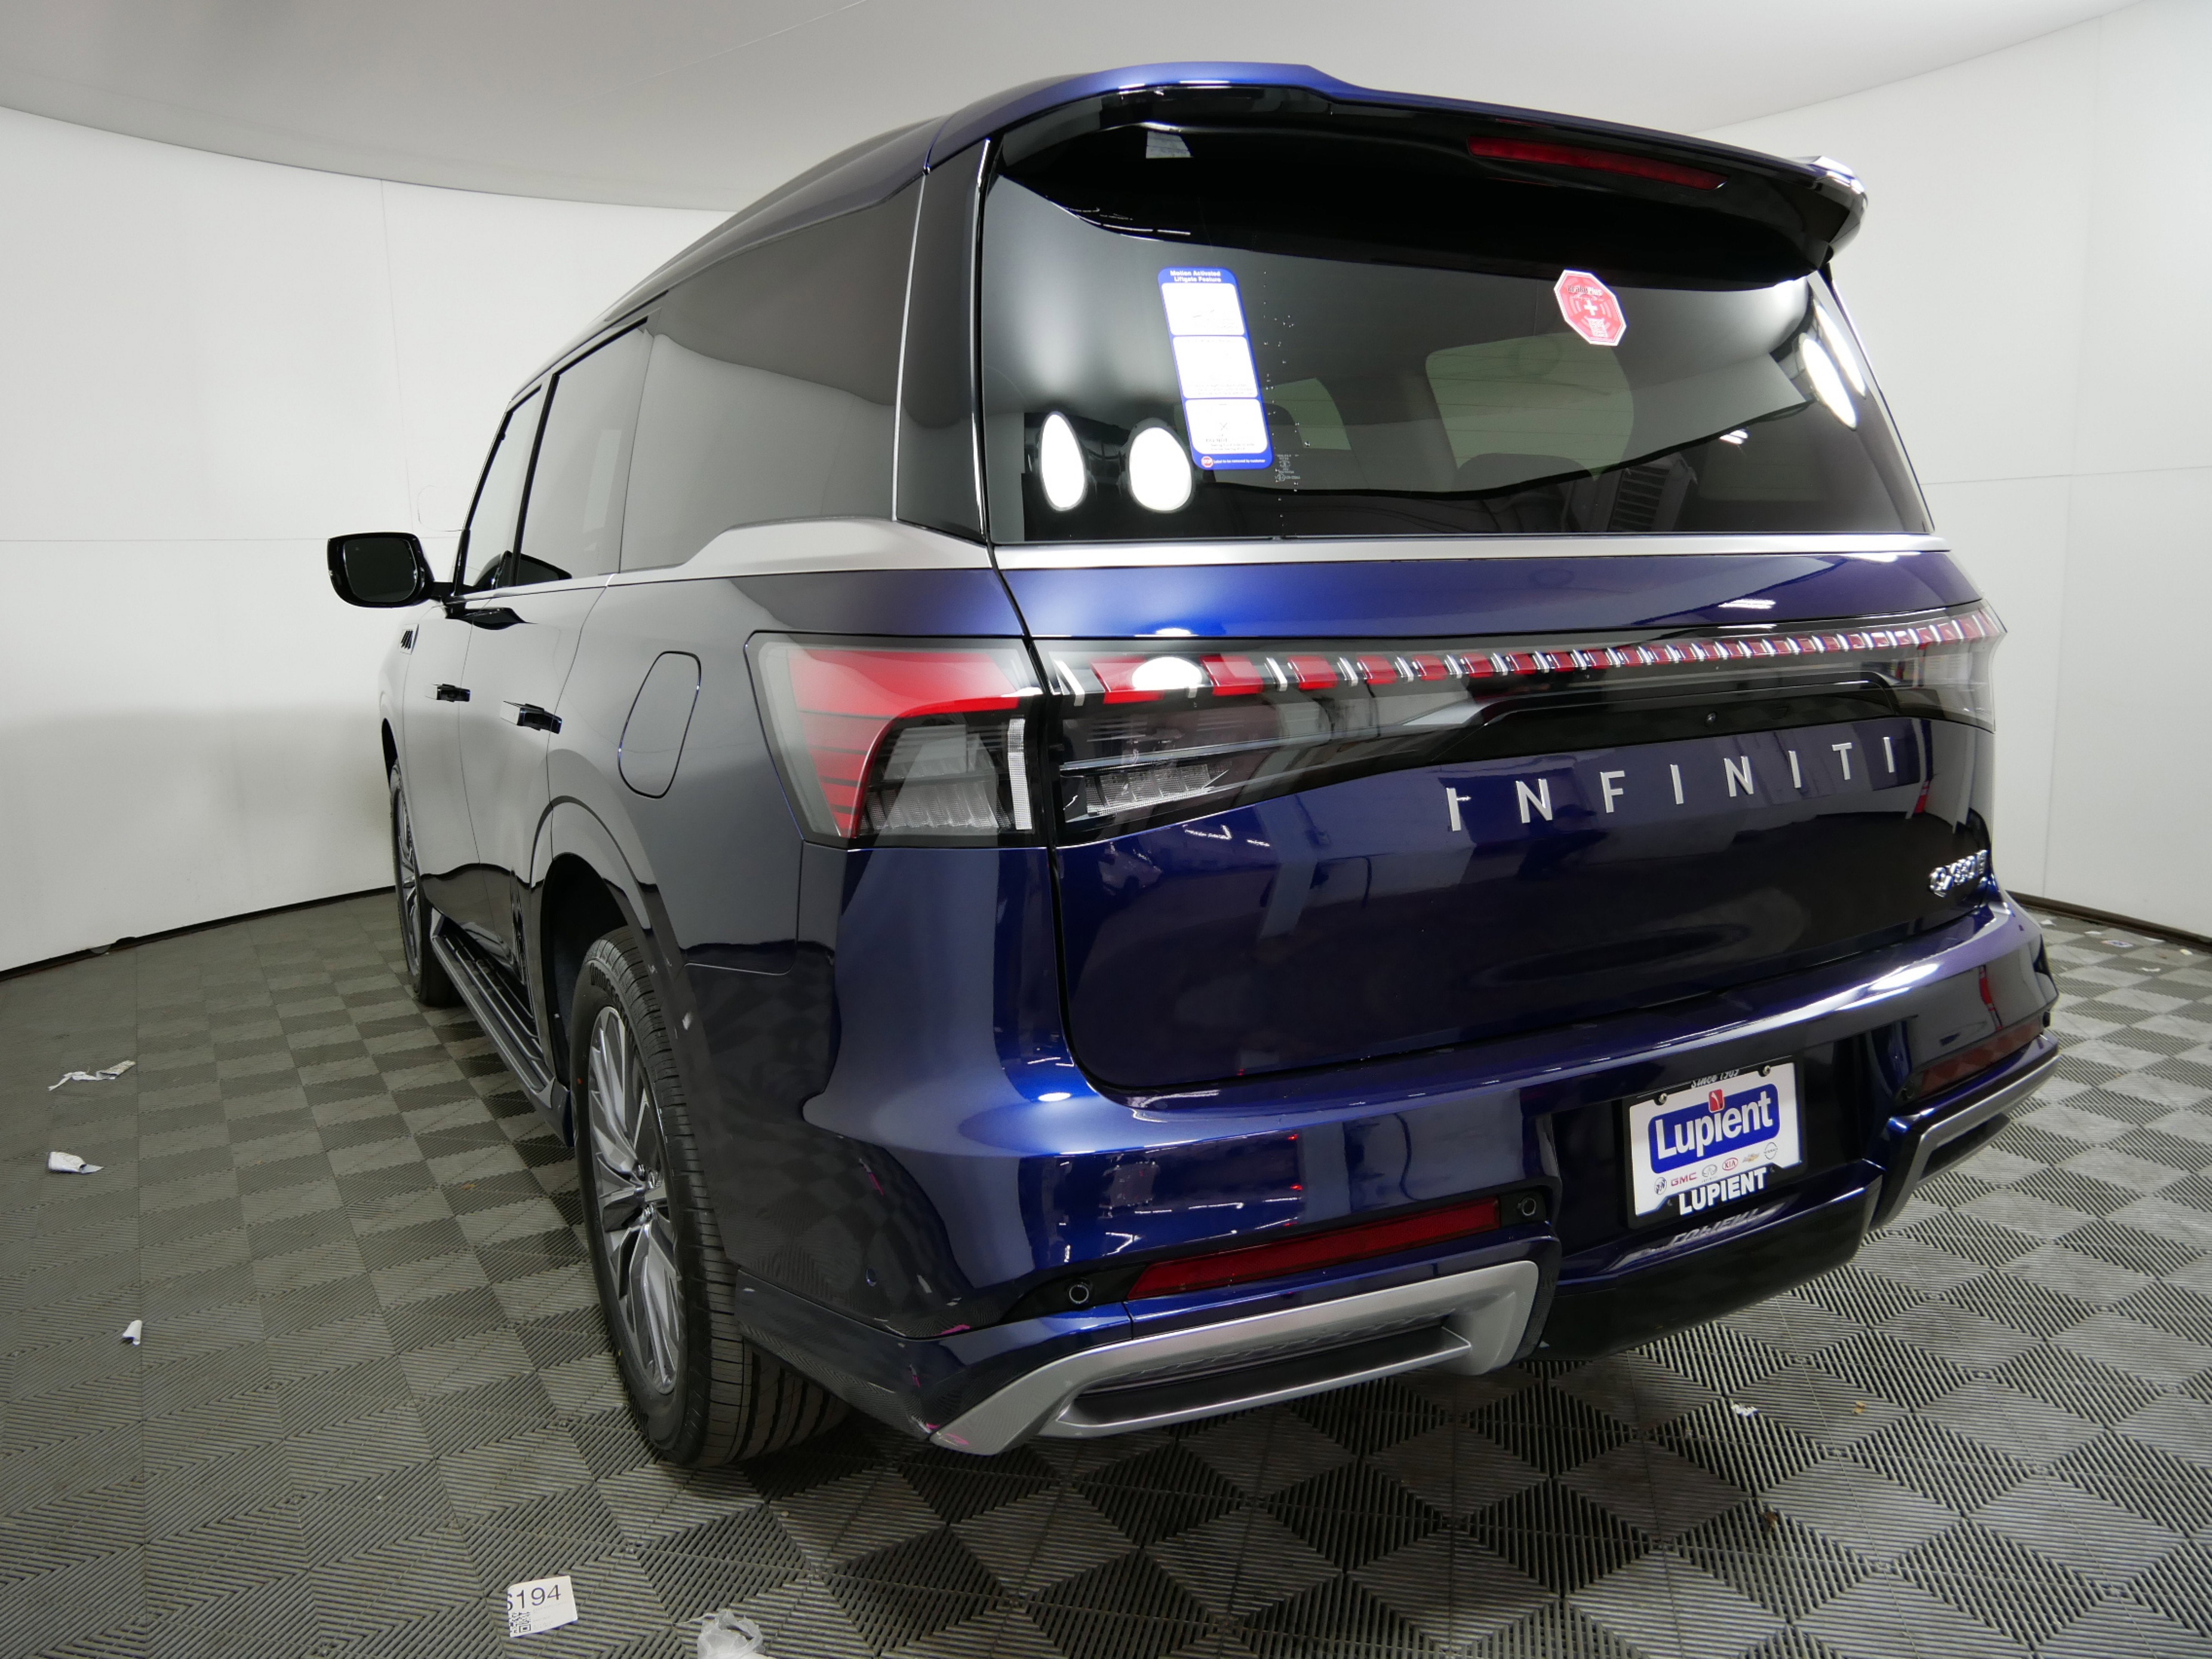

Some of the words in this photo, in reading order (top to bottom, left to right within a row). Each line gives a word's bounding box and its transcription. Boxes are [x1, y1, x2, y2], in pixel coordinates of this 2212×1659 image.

[1446, 737, 1896, 831] INFINITI
[1655, 1091, 1773, 1160] Lupient
[1671, 1172, 1698, 1186] GMC
[1725, 1160, 1736, 1169] KIA
[1679, 1167, 1767, 1215] LUPIENT
